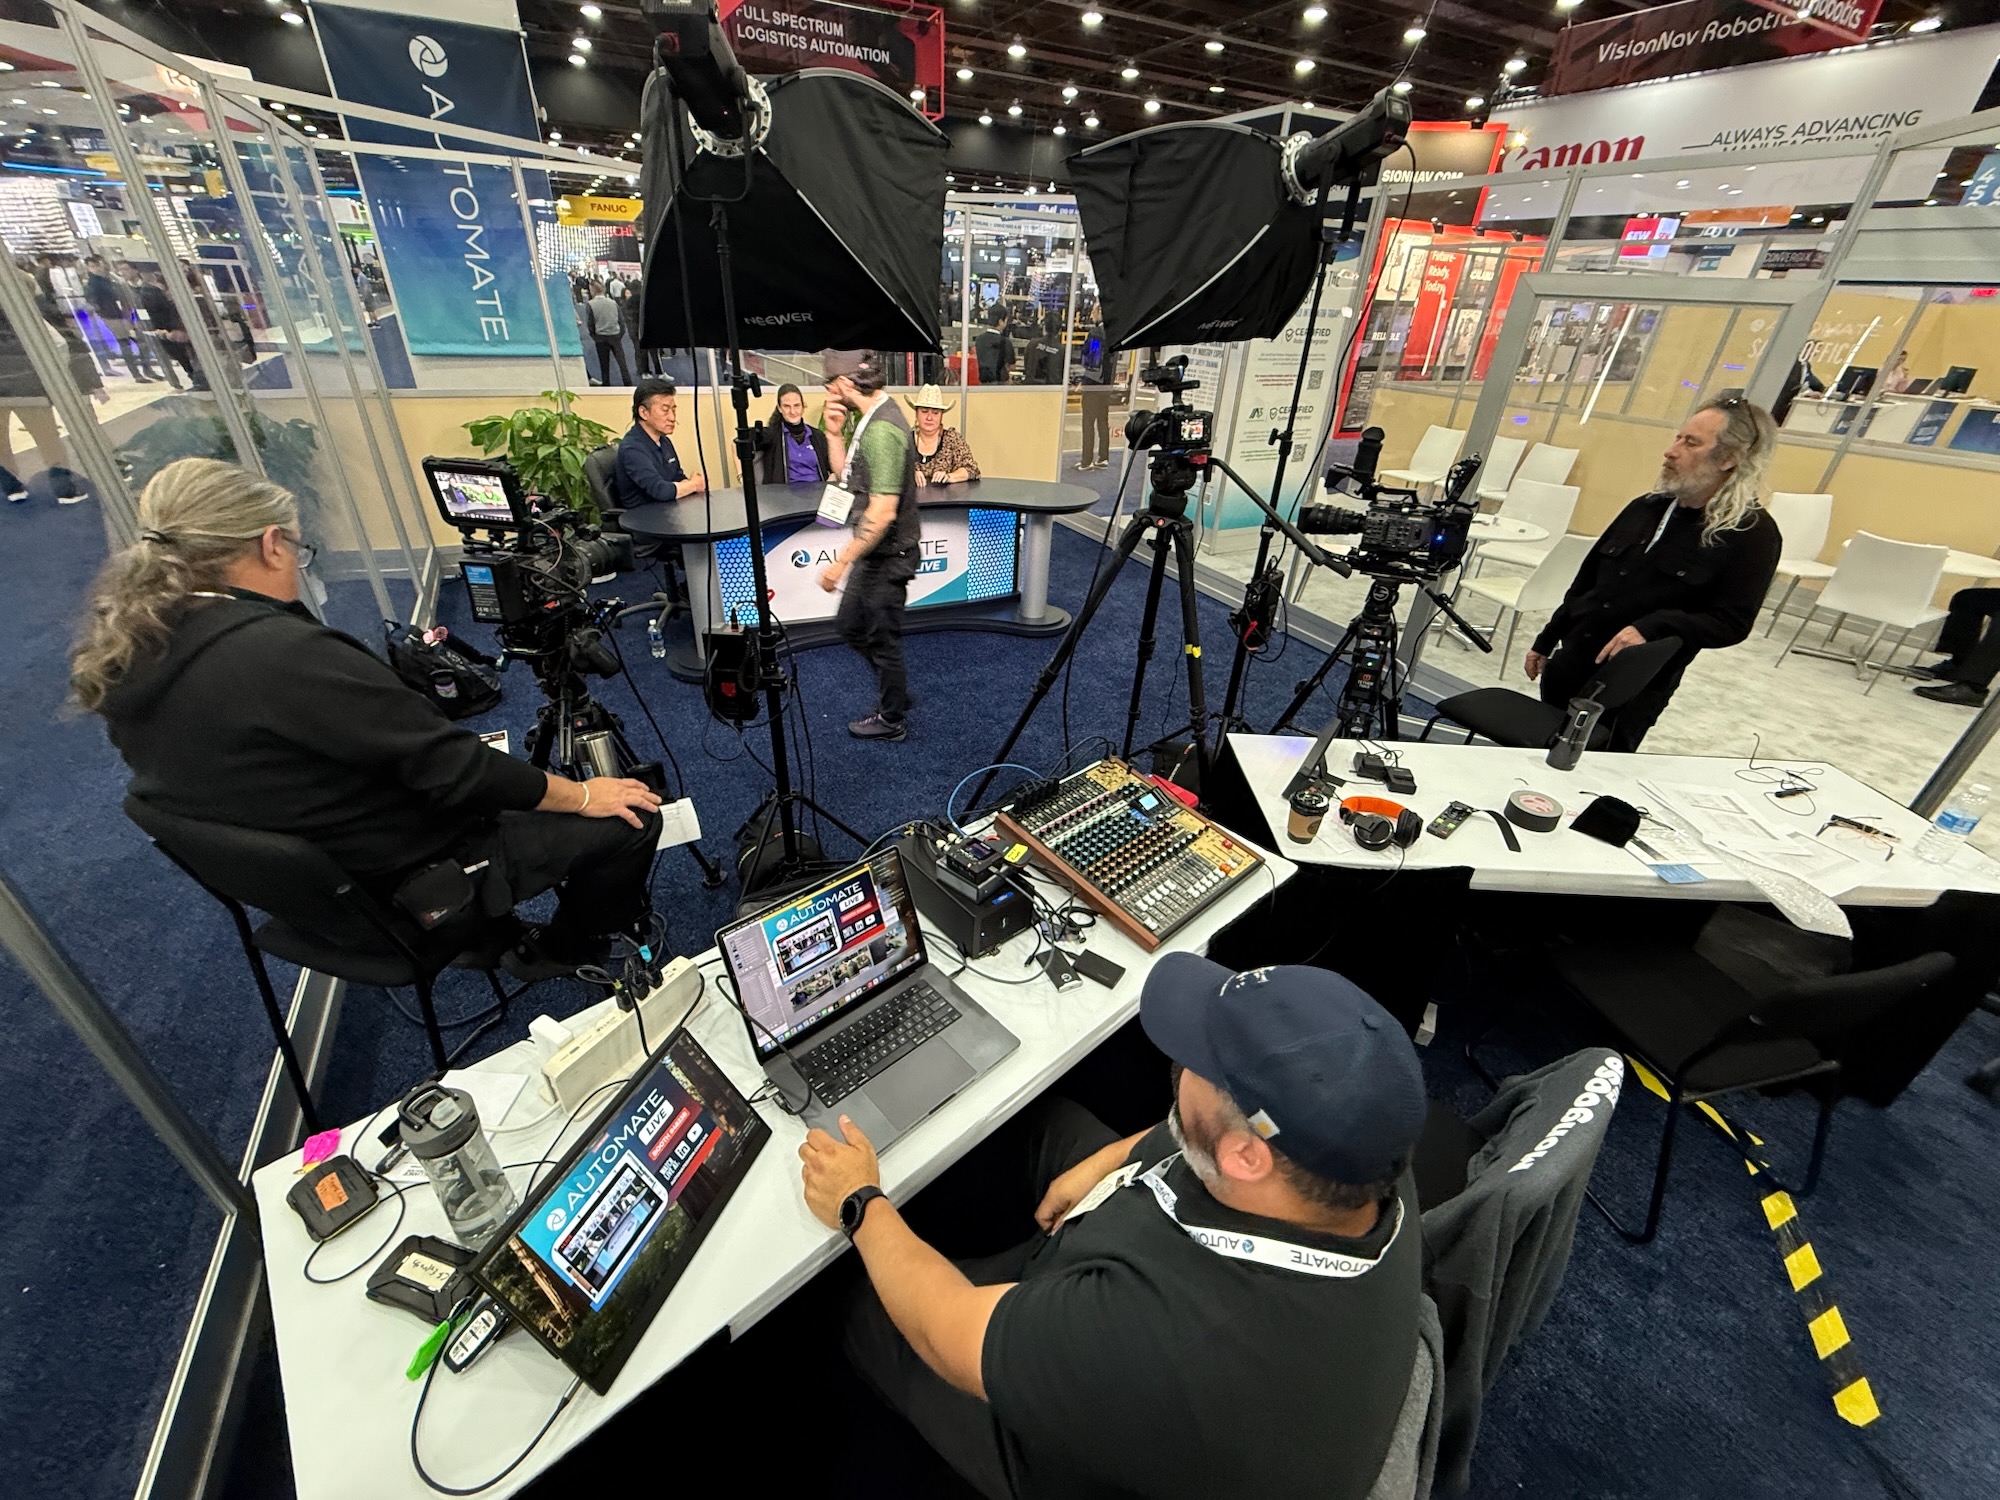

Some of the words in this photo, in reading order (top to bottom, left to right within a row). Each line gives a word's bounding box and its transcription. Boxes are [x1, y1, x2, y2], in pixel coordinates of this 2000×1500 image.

[772, 10, 844, 38] SPECTRUM
[736, 23, 808, 50] LOGISTICS
[809, 38, 890, 64] AUTOMATION
[1599, 29, 1699, 63] VisionNav
[1711, 124, 1788, 146] ALWAYS
[1792, 109, 1923, 138] ADVANCING
[590, 202, 628, 213] FANUC
[790, 881, 862, 926] AUTOMATE
[844, 895, 860, 908] LIVE
[645, 1107, 668, 1136] LIVE
[1507, 1056, 1624, 1173] mongoose
[567, 1088, 665, 1212] AUTOMATE
[652, 1133, 671, 1157] BOOTH
[677, 1145, 689, 1157] in
[1290, 1250, 1377, 1273] UTOMATE
